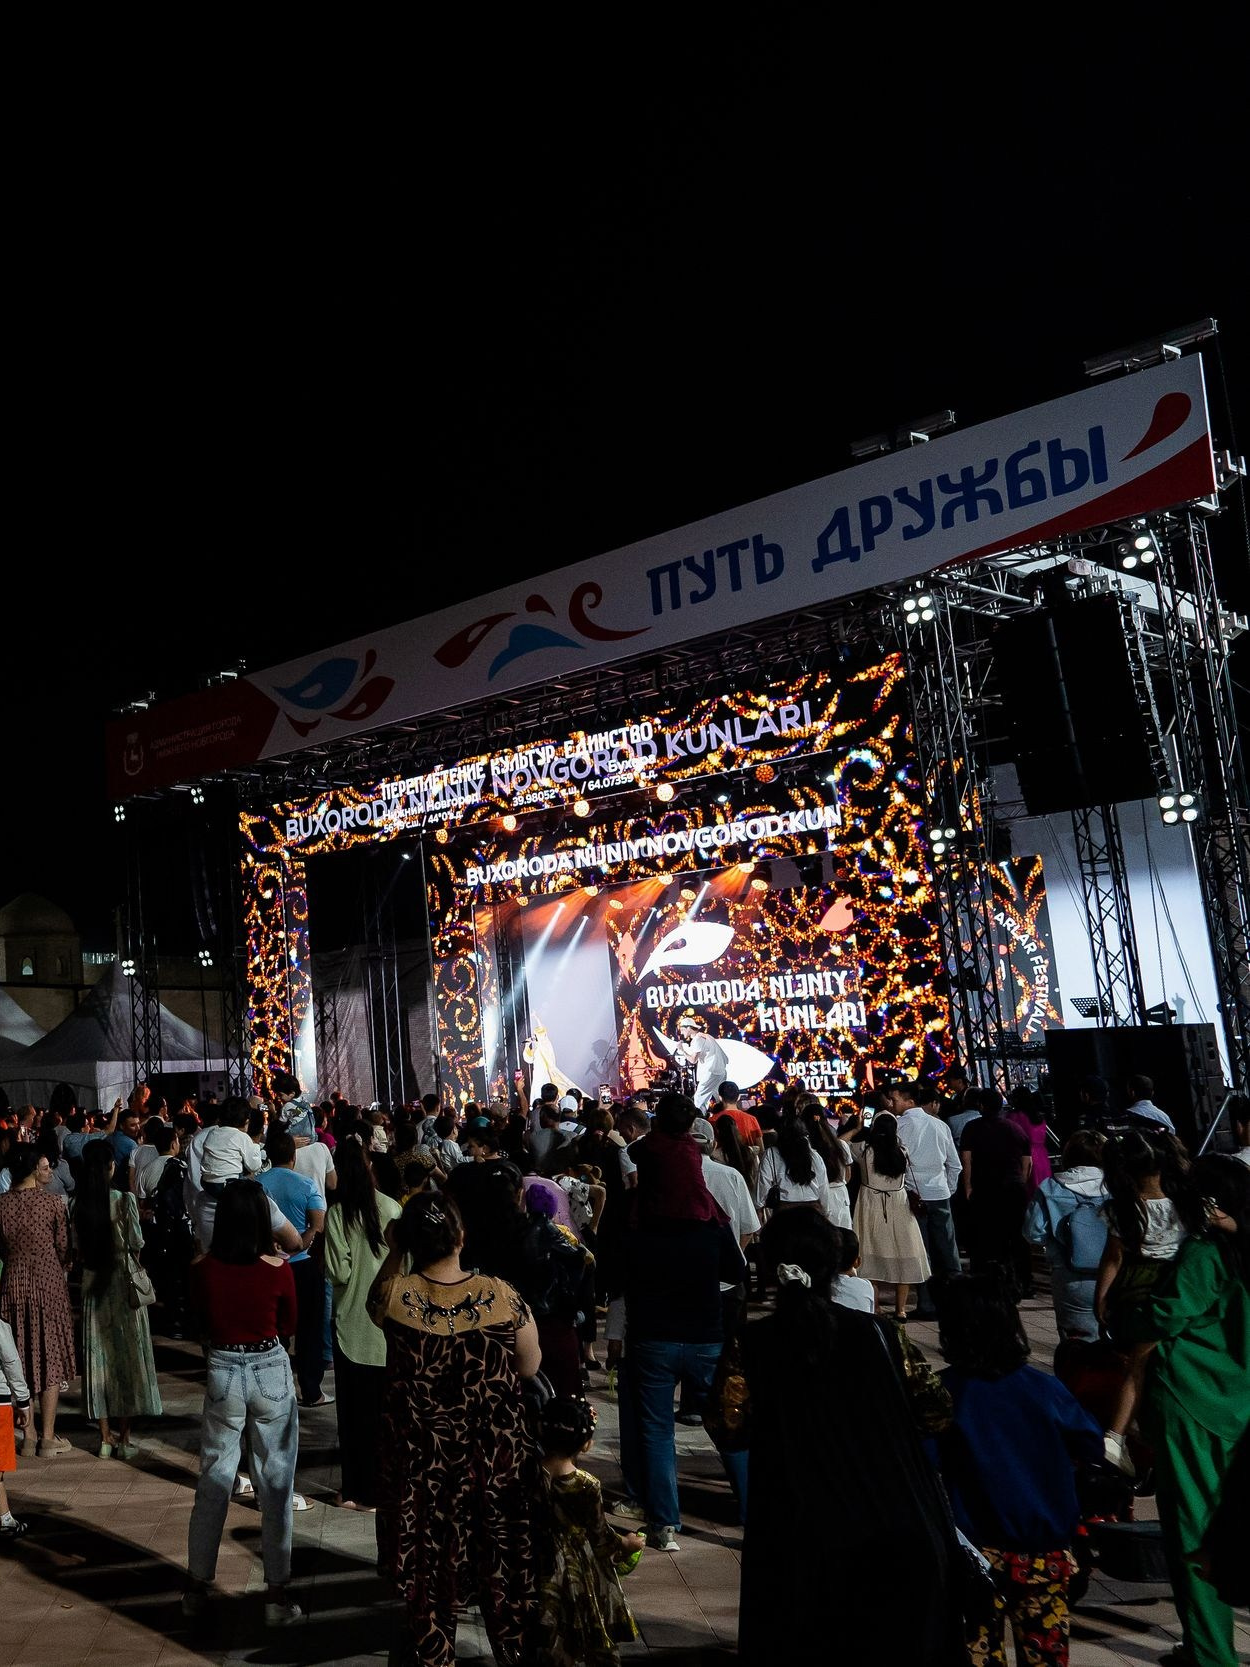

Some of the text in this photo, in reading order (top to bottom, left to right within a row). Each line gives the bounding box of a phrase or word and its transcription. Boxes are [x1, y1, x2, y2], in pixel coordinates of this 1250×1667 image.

[646, 425, 1109, 616] ПУТЬ ДРУЖБЫ
[285, 797, 403, 841] BUXORODA
[492, 738, 658, 798] NOVGOROD
[666, 700, 812, 759] KUNLARI
[382, 763, 486, 800] ПЕРЕПЛЕТЕНИЕ
[563, 721, 654, 760] ЕДИНСТВО
[466, 855, 574, 888] BUXORODA
[645, 816, 782, 857] NOVGOROD
[646, 970, 849, 1009] BUXORODA NIJNIY
[759, 1001, 867, 1032] KUNLARI
[1026, 955, 1050, 1033] FESTIVALI
